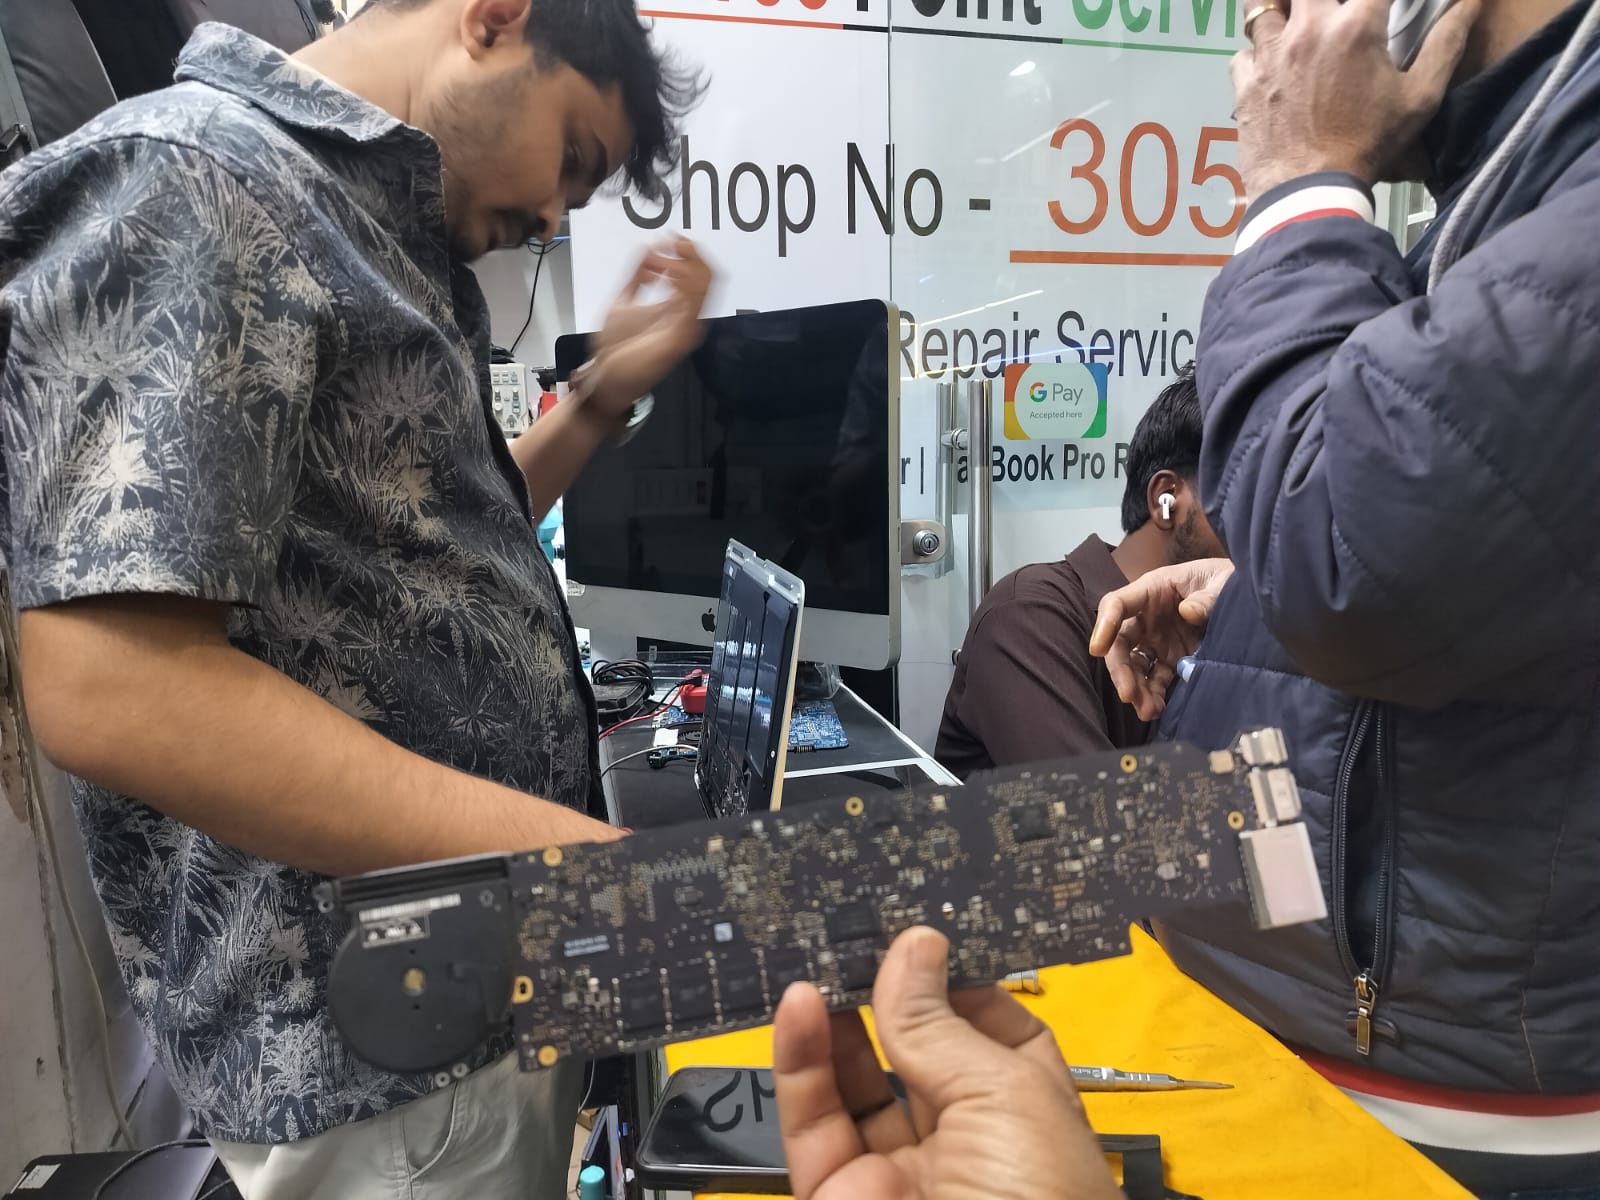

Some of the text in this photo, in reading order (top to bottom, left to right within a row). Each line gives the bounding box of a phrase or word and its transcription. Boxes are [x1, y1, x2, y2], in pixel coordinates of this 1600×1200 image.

[847, 142, 942, 236] No
[1047, 117, 1246, 238] 305
[1056, 310, 1194, 377] Servic
[1052, 383, 1083, 406] Pay
[1030, 411, 1064, 420] Accepted
[1063, 443, 1105, 480] Pro
